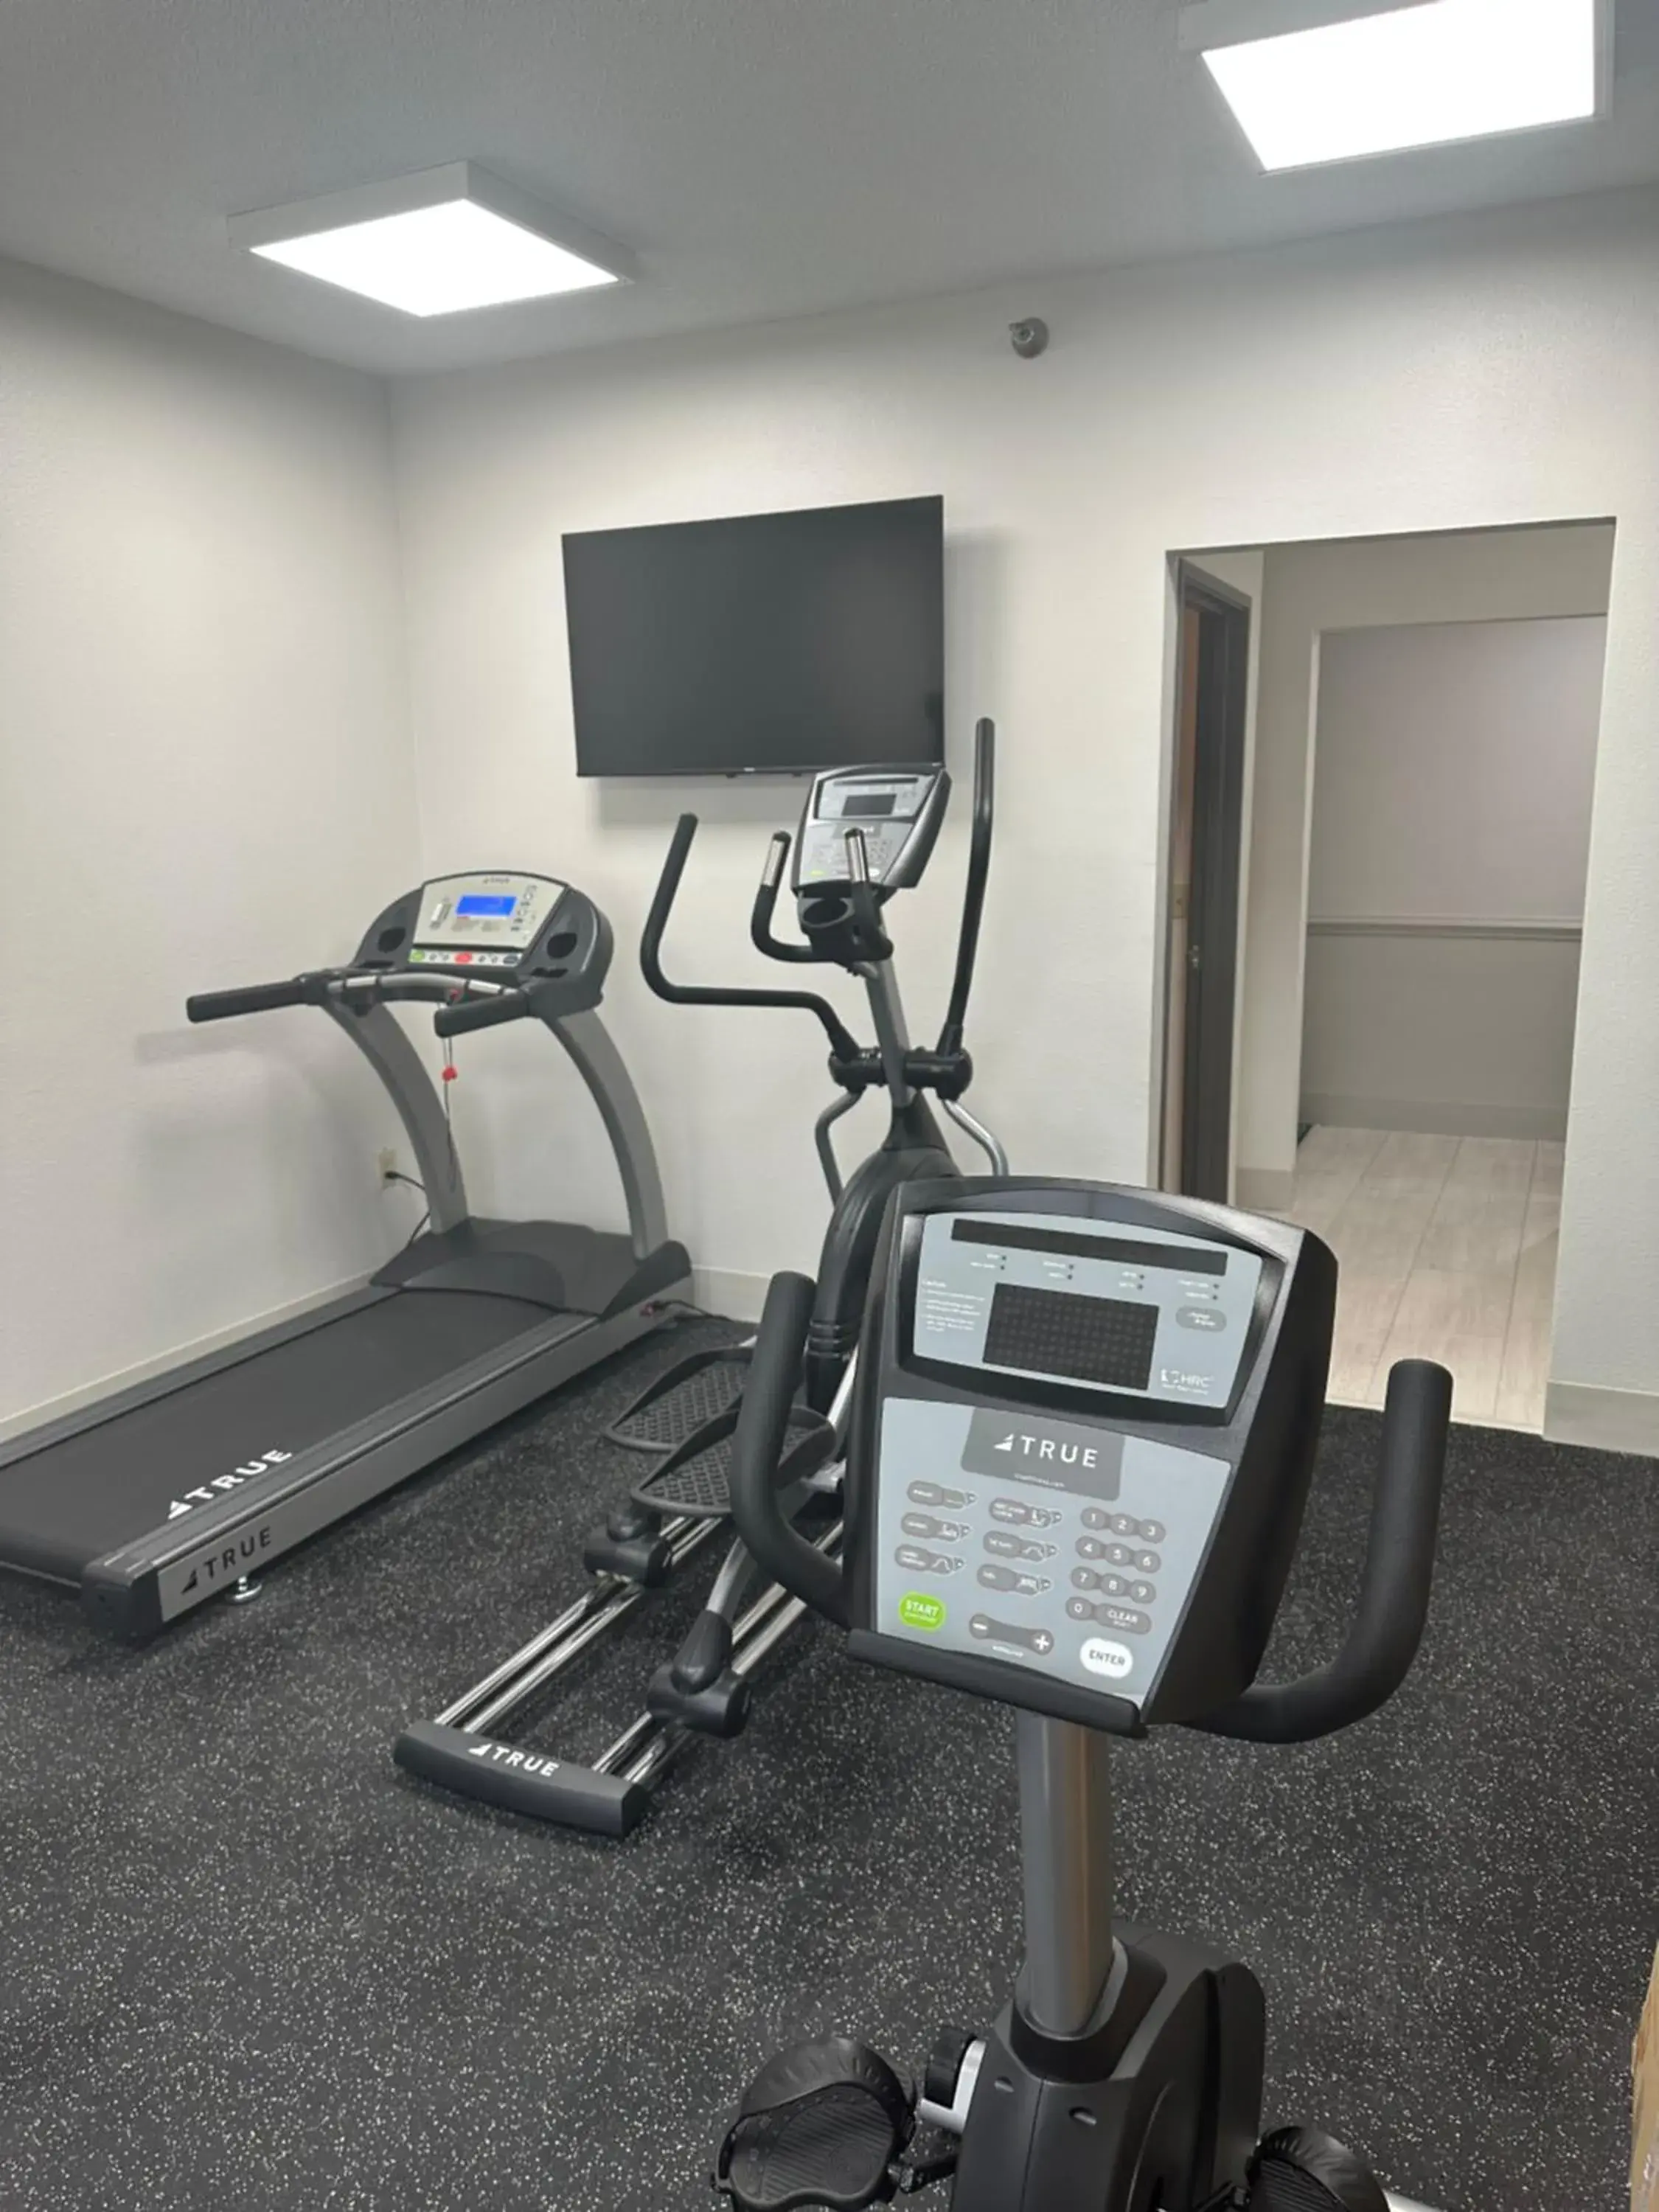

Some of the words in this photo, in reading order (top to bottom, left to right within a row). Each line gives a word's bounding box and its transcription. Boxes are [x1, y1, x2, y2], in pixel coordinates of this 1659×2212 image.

[1020, 1434, 1099, 1469] TRUE
[184, 1449, 293, 1500] TRUE
[1118, 1519, 1127, 1531] 2
[203, 1526, 272, 1579] TRUE
[1083, 1543, 1093, 1552] 4
[1142, 1556, 1152, 1567] 6
[1079, 1571, 1088, 1583] 7
[1108, 1579, 1118, 1590] 8
[1138, 1586, 1147, 1597] 9
[905, 1599, 939, 1618] START
[1106, 1609, 1139, 1624] CLEAR
[1088, 1649, 1127, 1666] ENTER
[493, 1745, 560, 1777] TRUE
